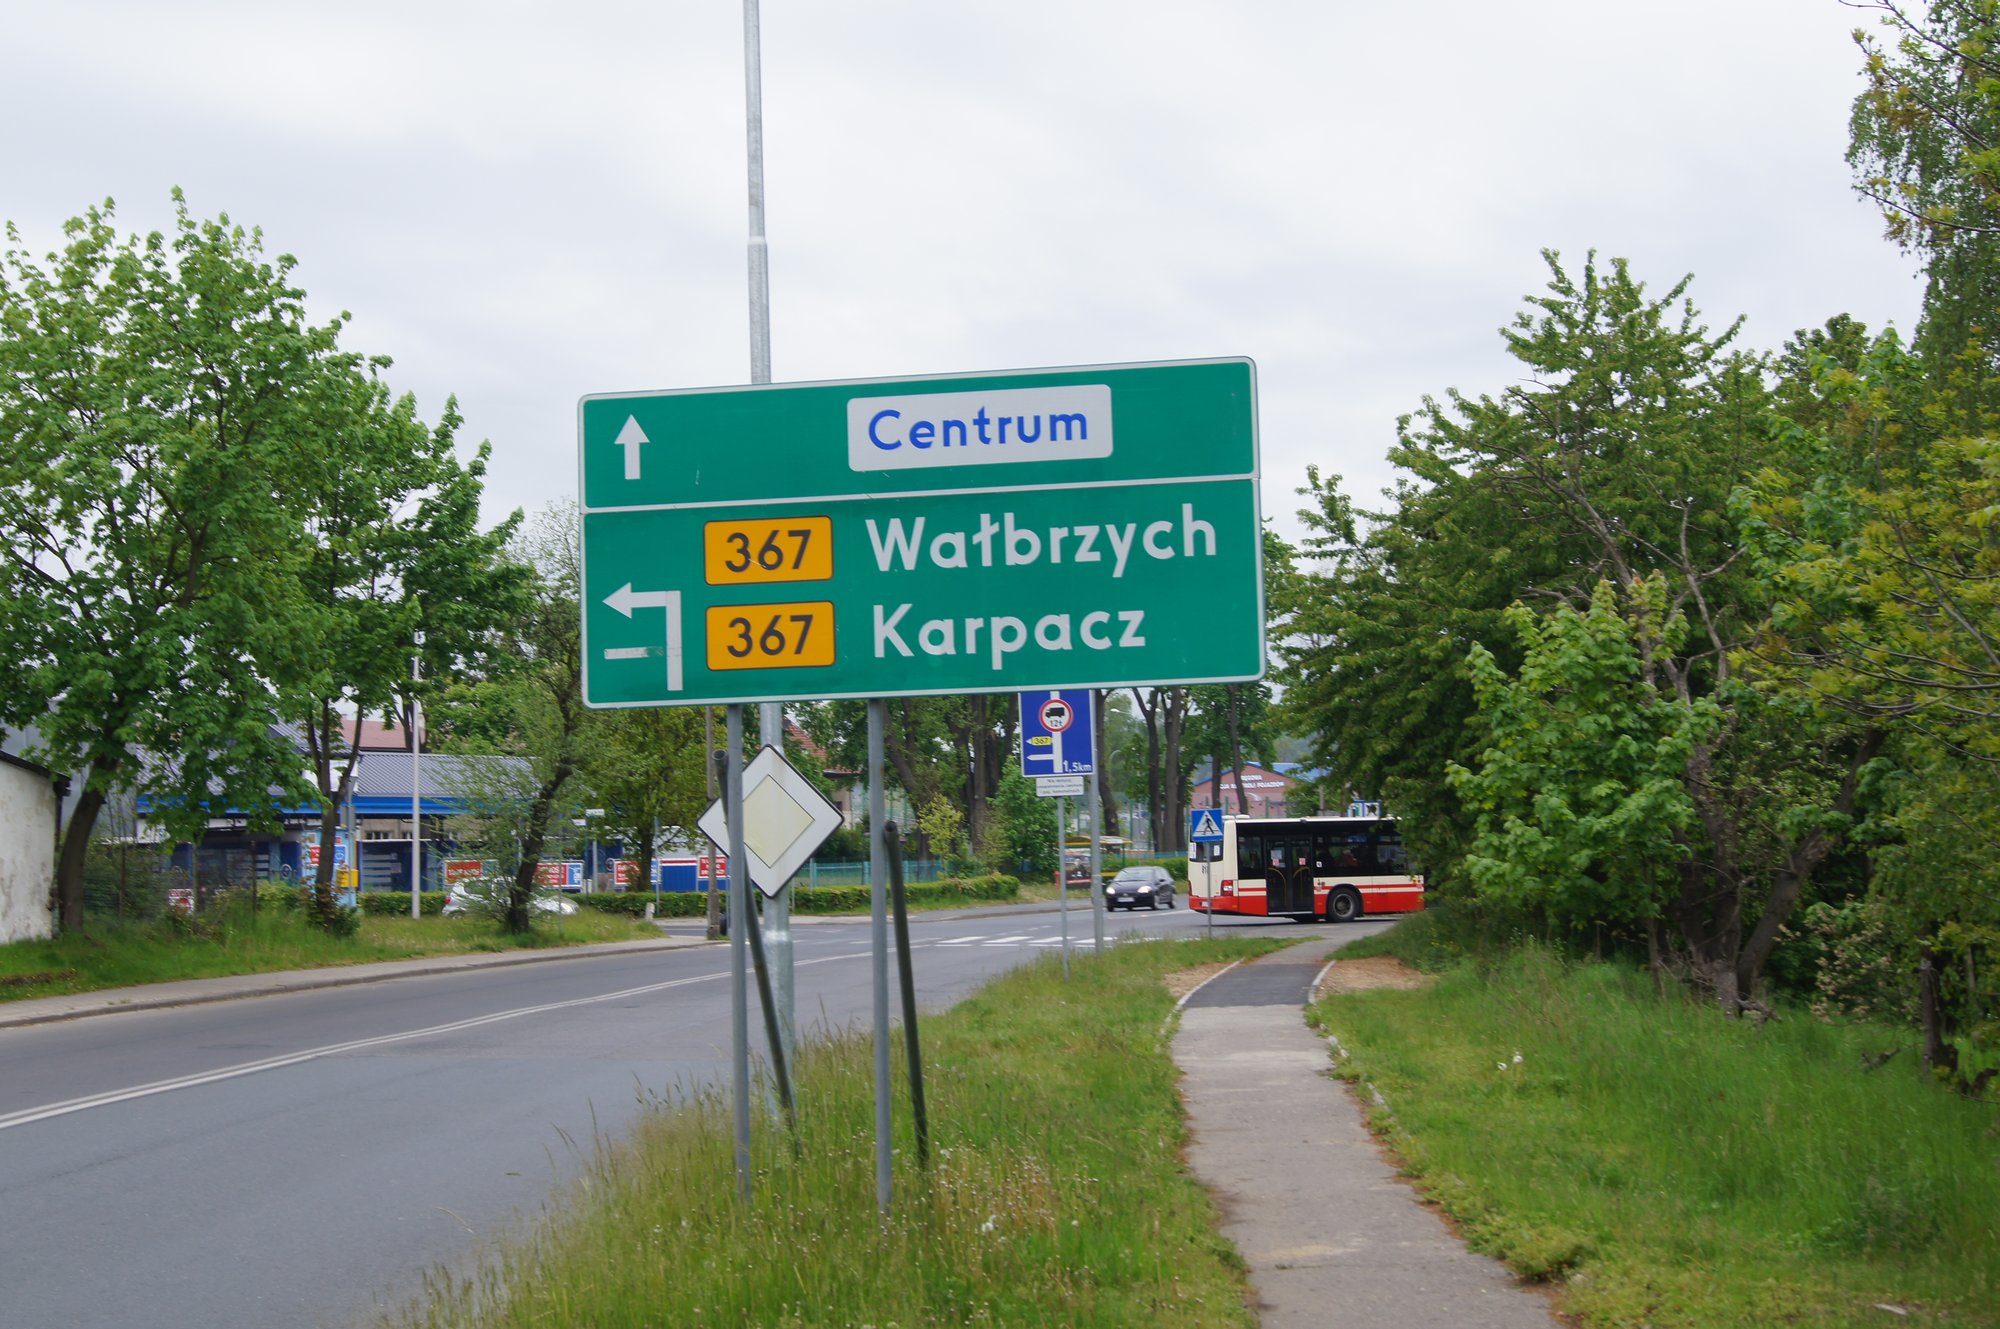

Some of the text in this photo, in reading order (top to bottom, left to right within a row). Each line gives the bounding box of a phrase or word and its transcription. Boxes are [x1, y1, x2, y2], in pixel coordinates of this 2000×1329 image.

[867, 406, 1089, 451] Centrum
[725, 503, 1217, 578] 367 Wałbrzych
[727, 603, 1146, 671] 367 Karpacz
[1034, 737, 1049, 745] 367
